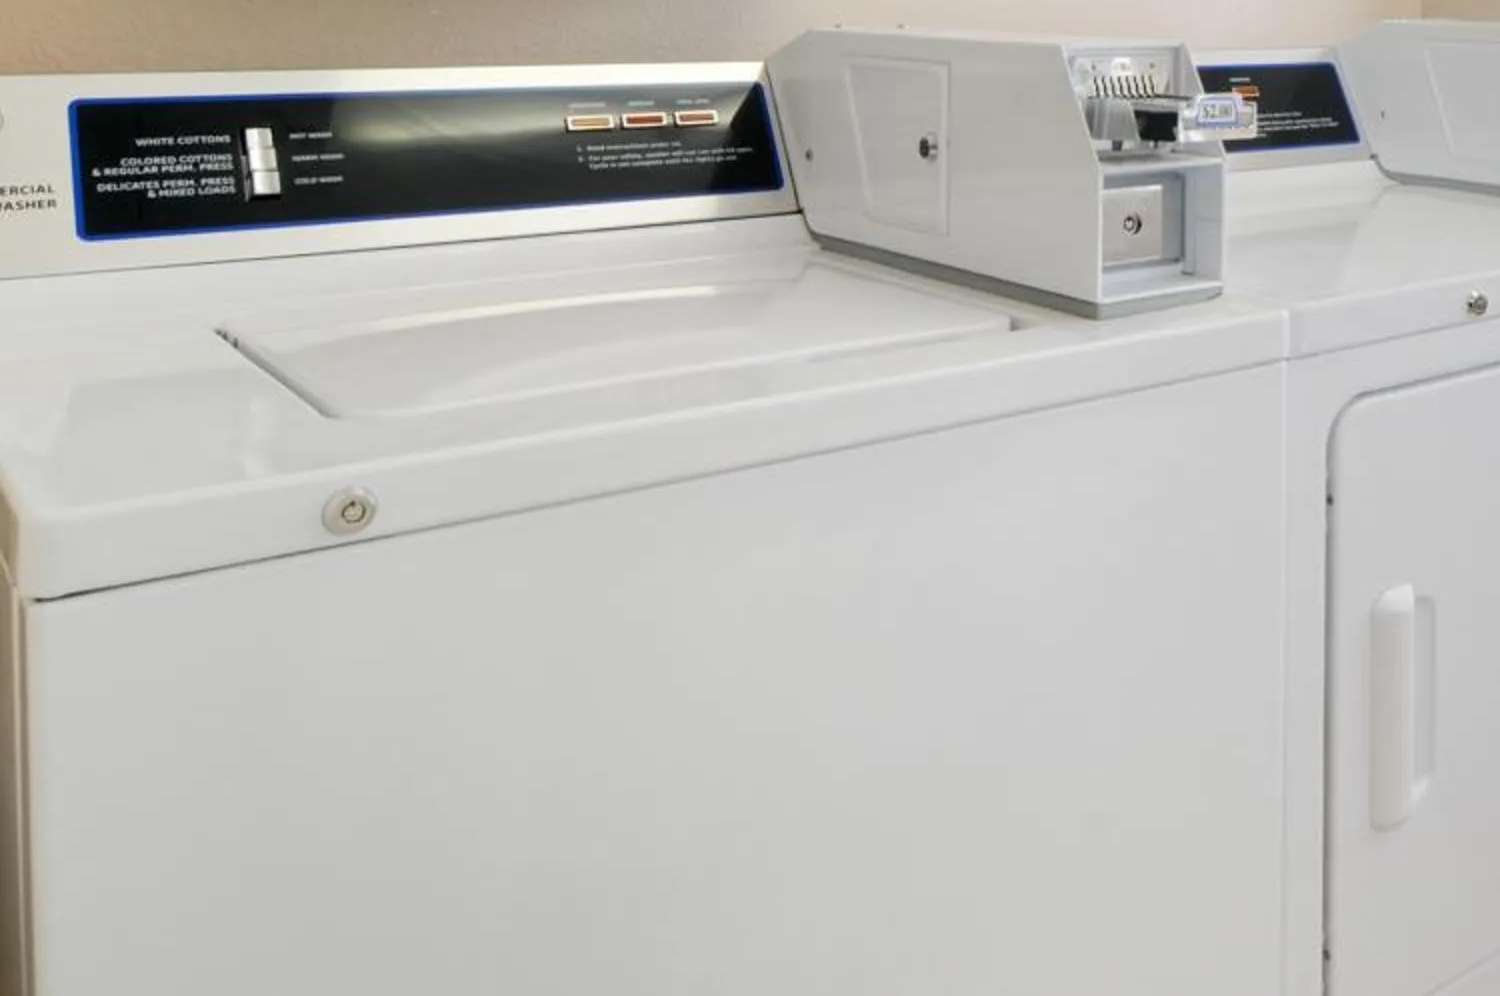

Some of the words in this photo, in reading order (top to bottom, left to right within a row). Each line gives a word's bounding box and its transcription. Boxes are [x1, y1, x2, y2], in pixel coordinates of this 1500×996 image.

[135, 136, 175, 147] WHITE
[177, 135, 231, 145] COTTONS
[120, 155, 177, 166] COLORED
[179, 153, 233, 164] COTTONS
[103, 165, 159, 176] REGULAR
[161, 164, 196, 174] PERM.
[199, 162, 234, 171] PRESS
[97, 180, 160, 192] DELICATES
[162, 178, 198, 188] PERM.
[201, 176, 236, 186] PRESS
[158, 187, 195, 197] MIXED
[198, 186, 236, 195] LOADS
[0, 199, 57, 211] ASHER
